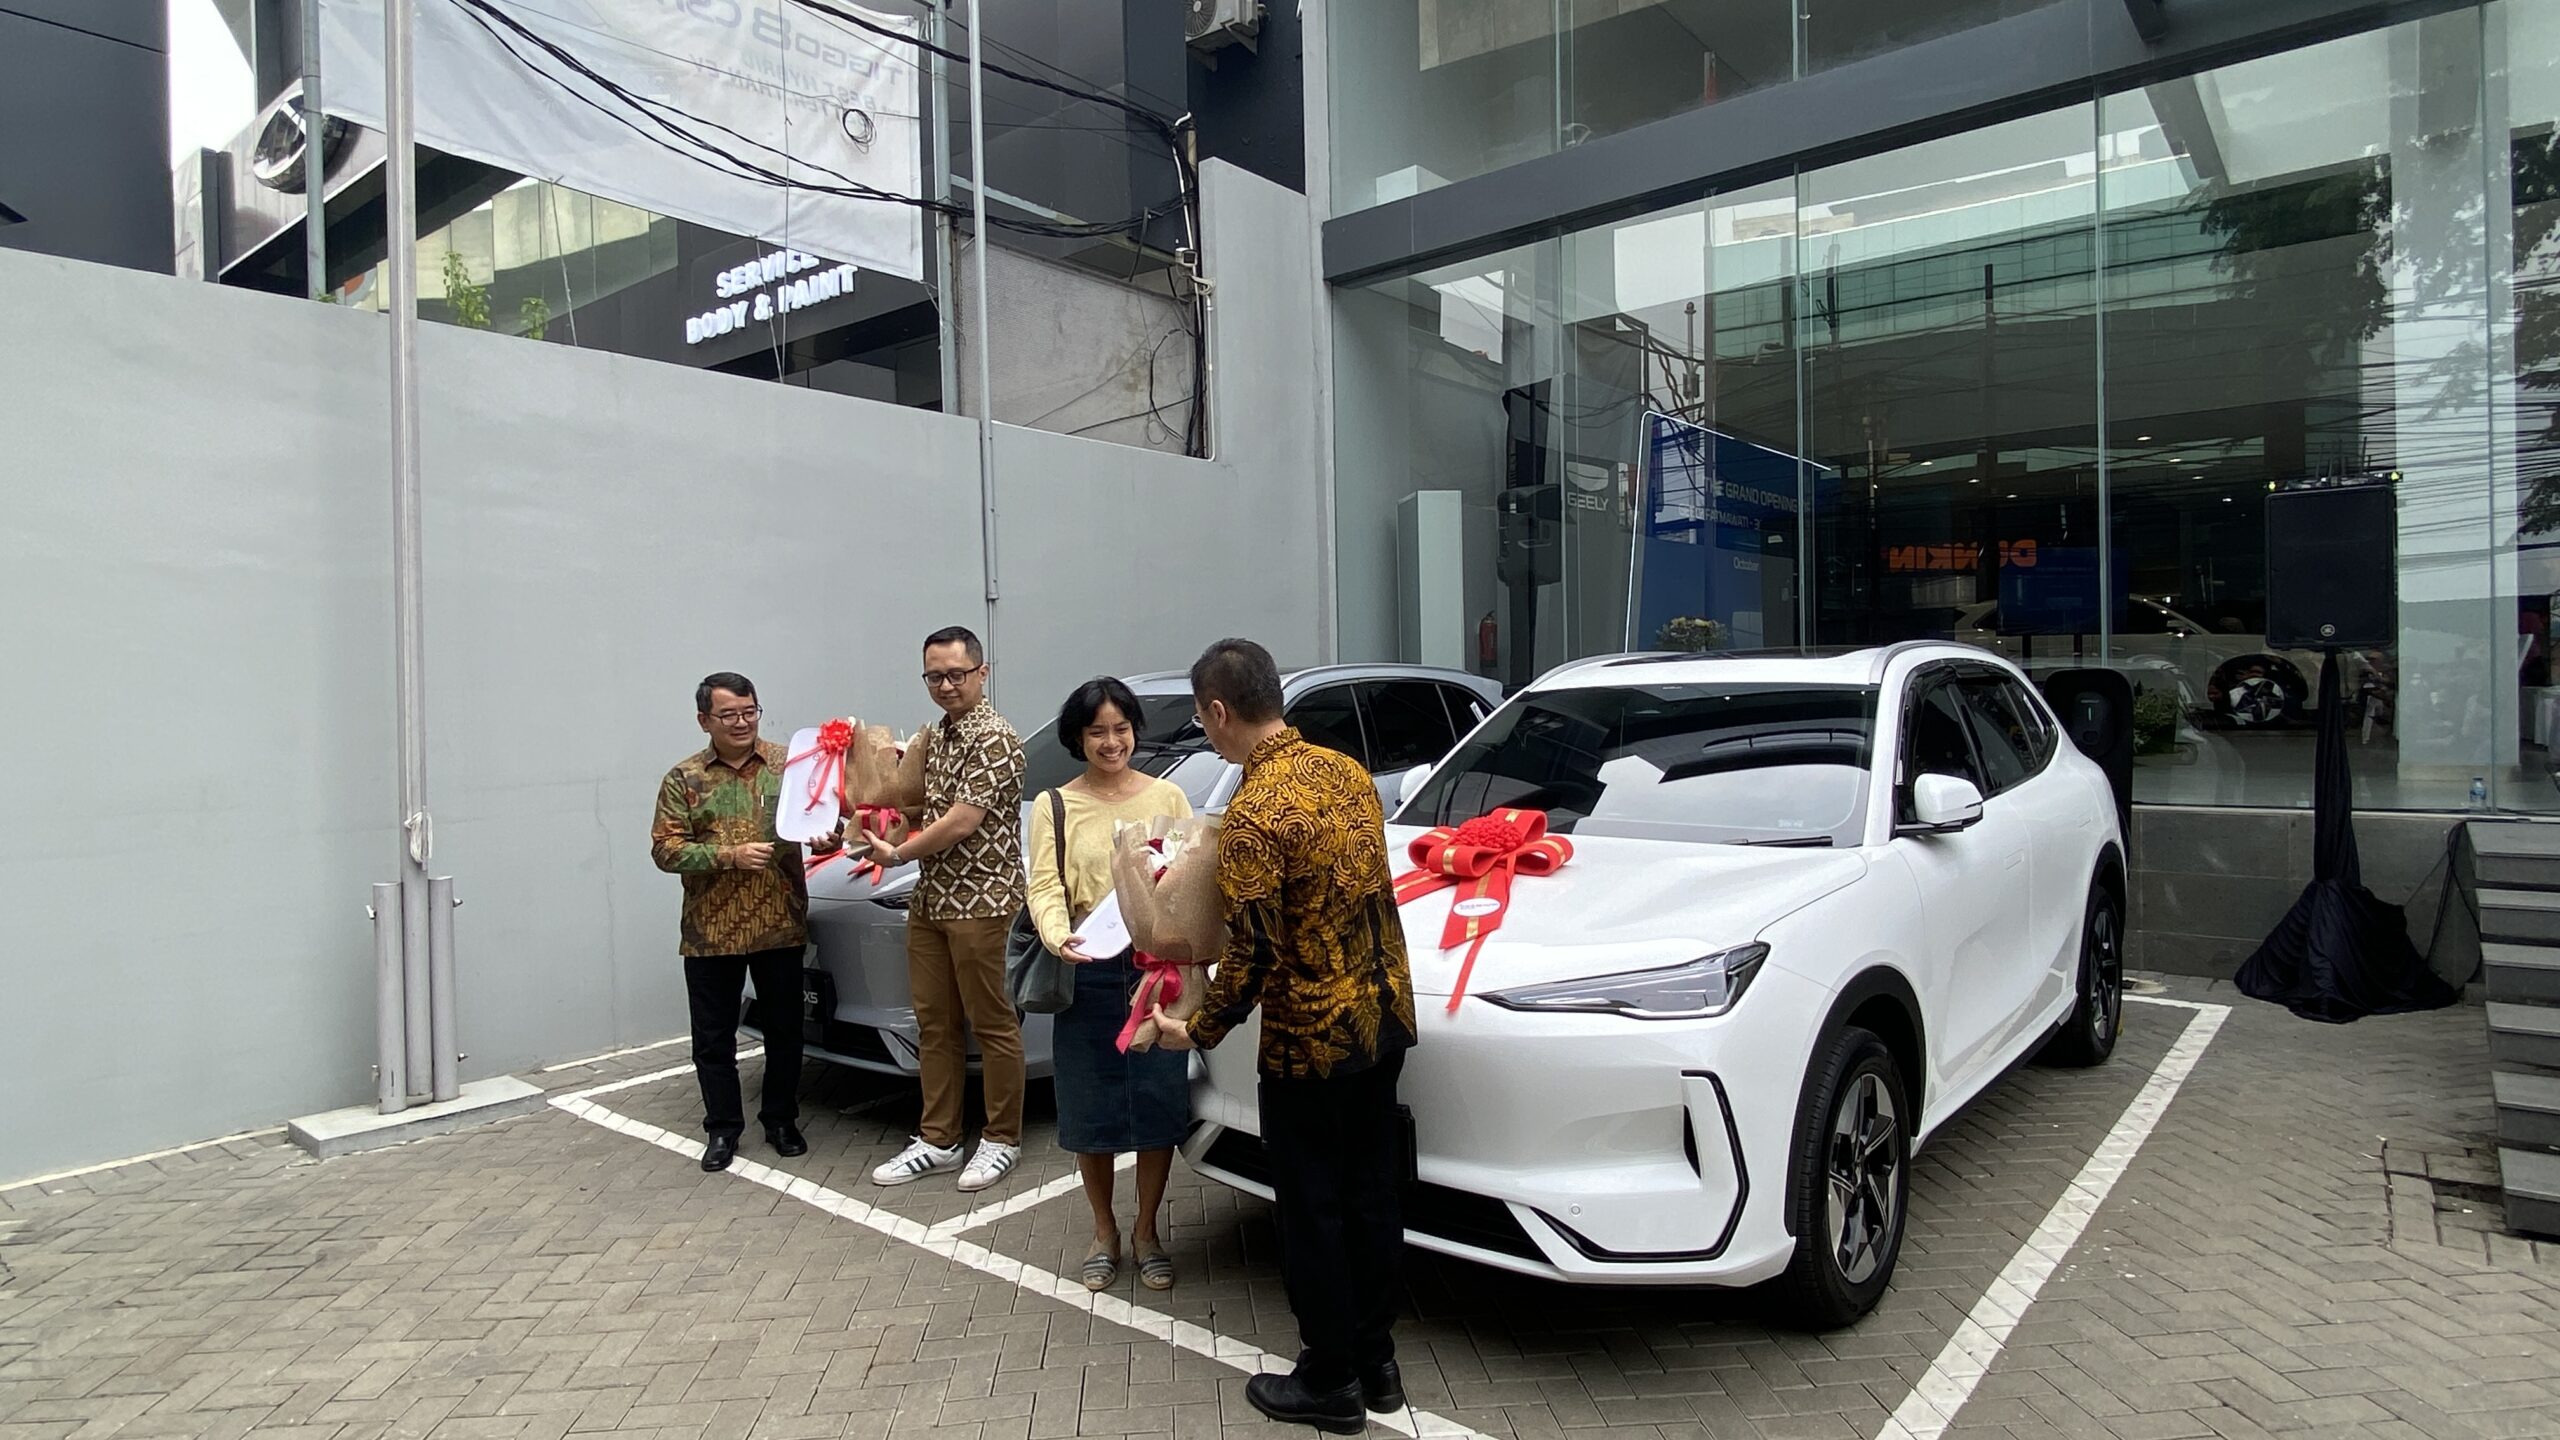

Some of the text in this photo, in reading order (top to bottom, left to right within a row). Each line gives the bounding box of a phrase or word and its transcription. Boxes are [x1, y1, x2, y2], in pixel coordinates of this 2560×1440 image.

[716, 249, 820, 298] SERVICE
[686, 264, 858, 344] BODY & PAINT
[1567, 492, 1609, 512] GEELY
[1725, 483, 1758, 504] GRAND
[1760, 490, 1798, 513] OPENING
